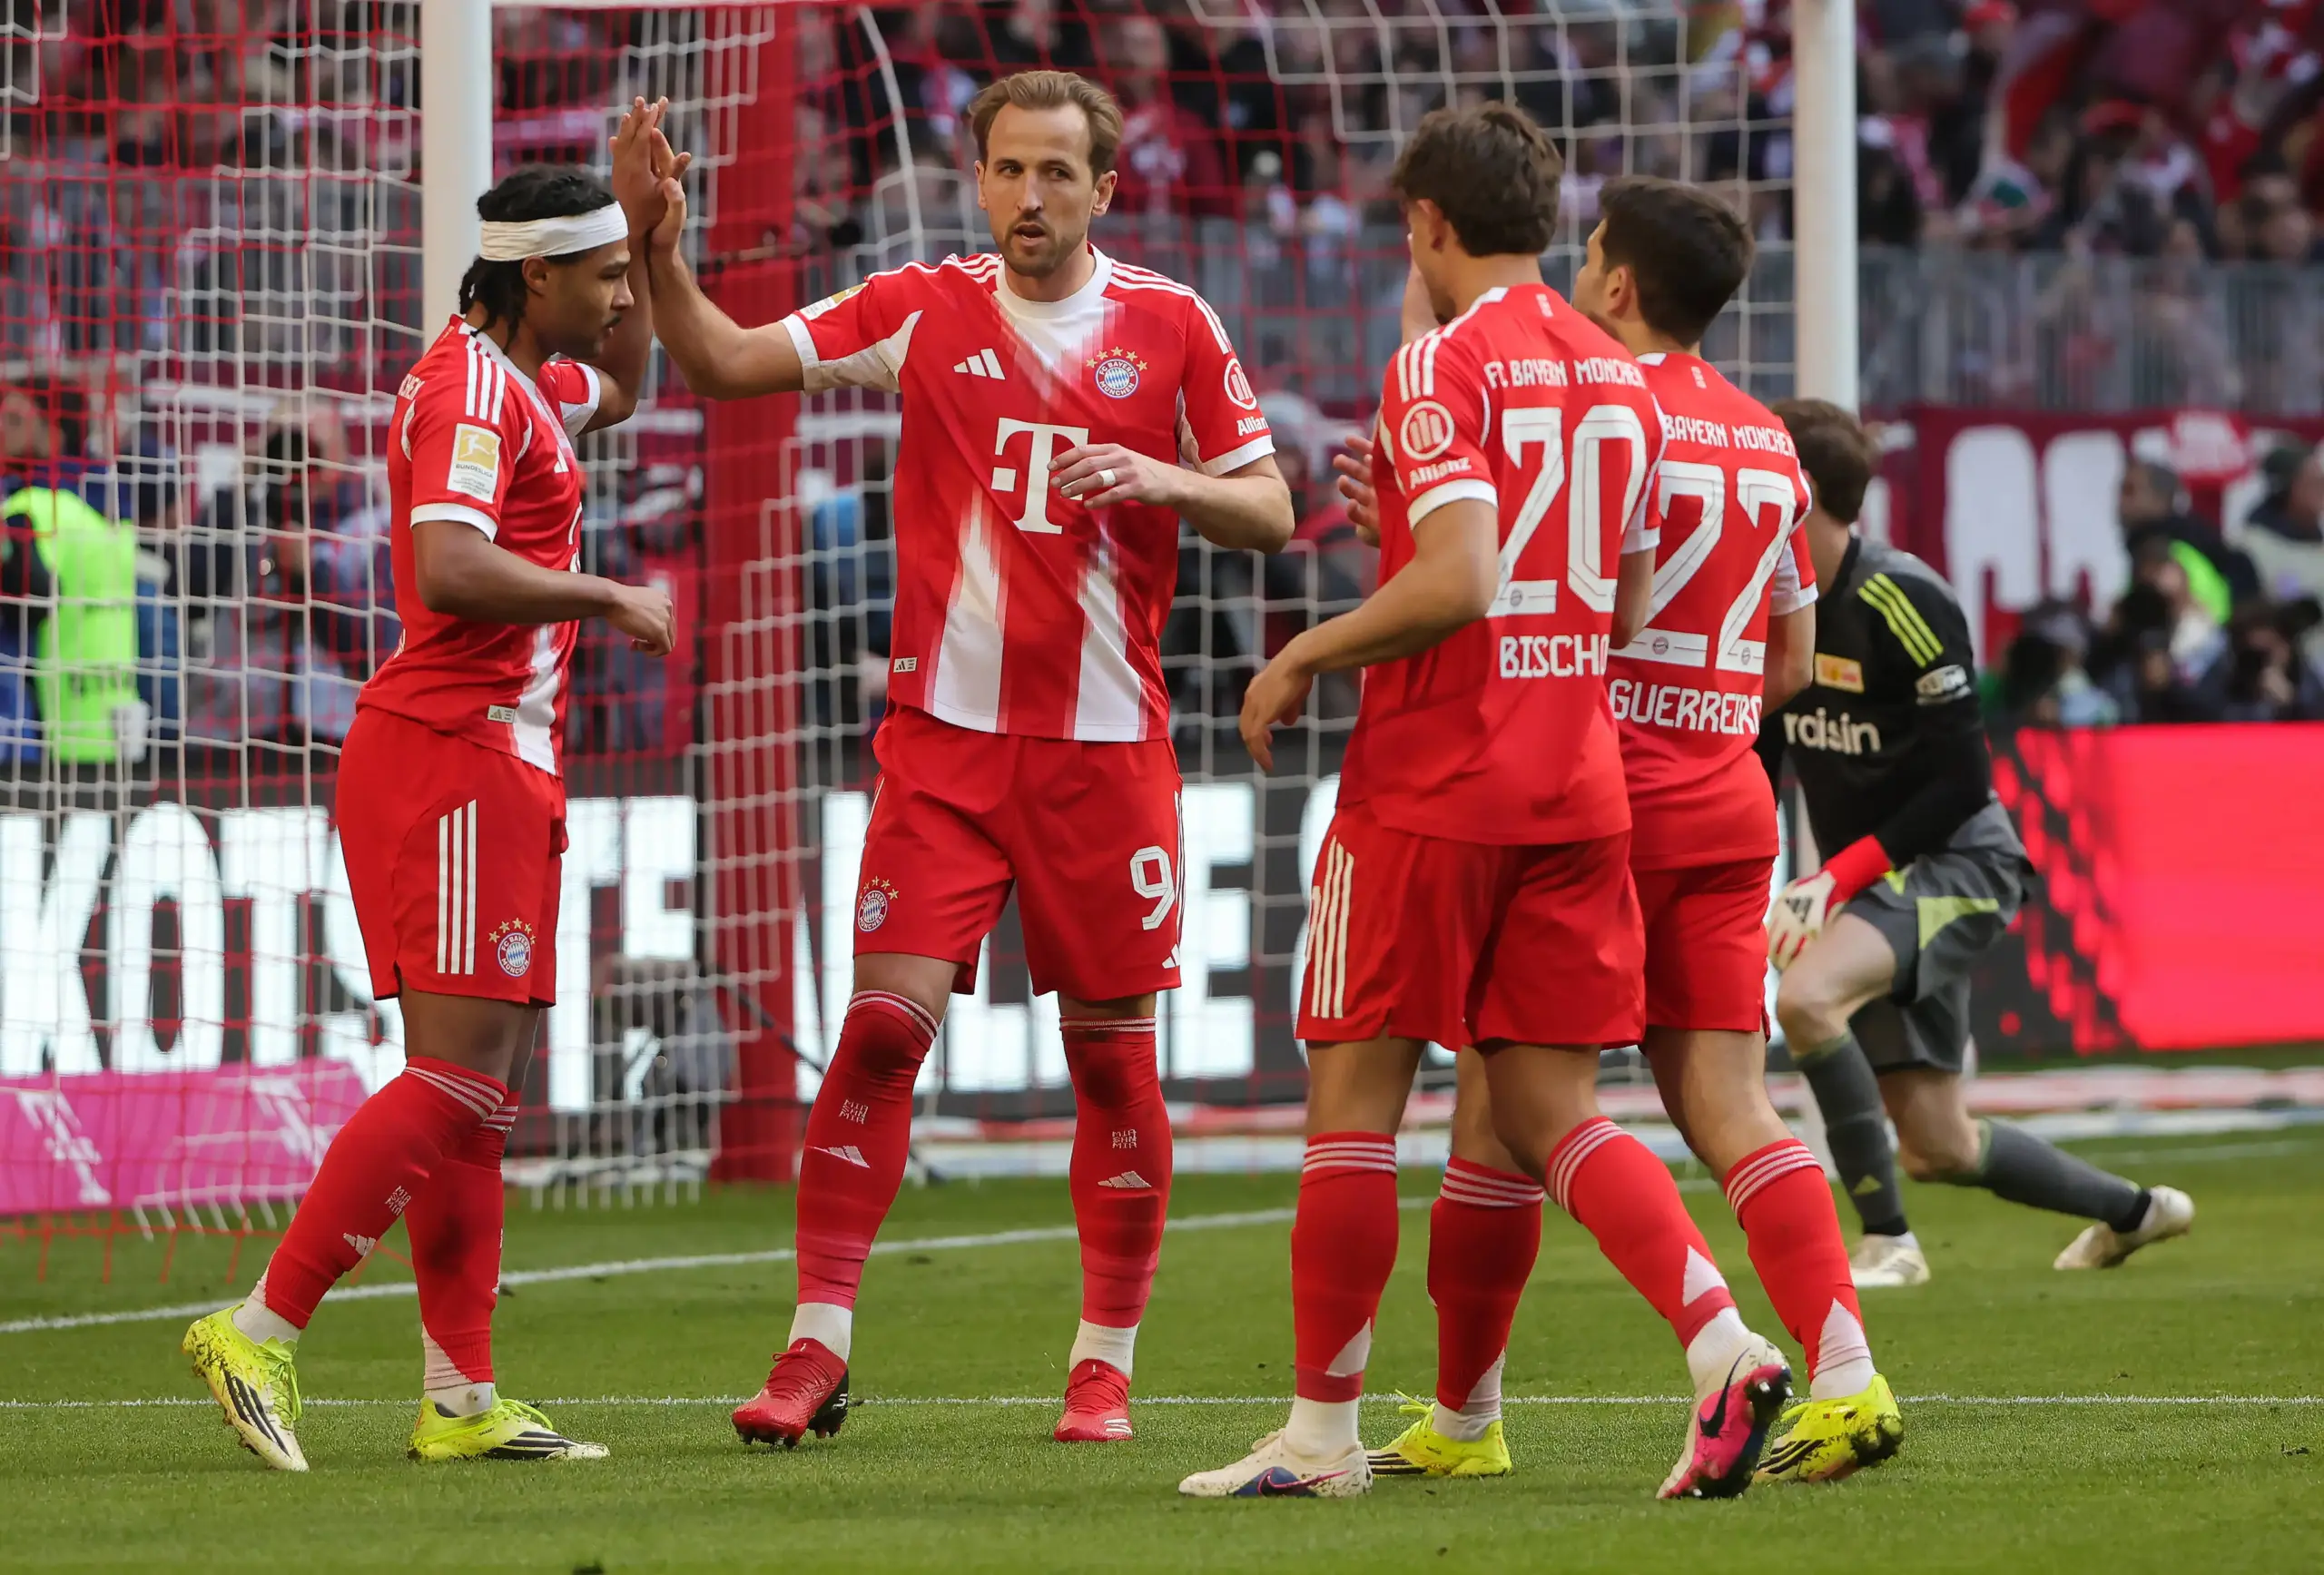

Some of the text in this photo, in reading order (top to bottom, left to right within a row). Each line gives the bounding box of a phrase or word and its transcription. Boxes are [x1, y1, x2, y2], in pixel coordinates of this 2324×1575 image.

[1108, 362, 1135, 377] BAYERN
[1663, 414, 1728, 448] BAYERN
[456, 463, 493, 478] BUNDESLIGA
[994, 417, 1089, 535] T
[1409, 457, 1472, 490] Allianz
[1484, 404, 1646, 618] 20
[1608, 461, 1796, 674] 22
[1783, 706, 1881, 755] raisin
[1129, 845, 1175, 930] 9
